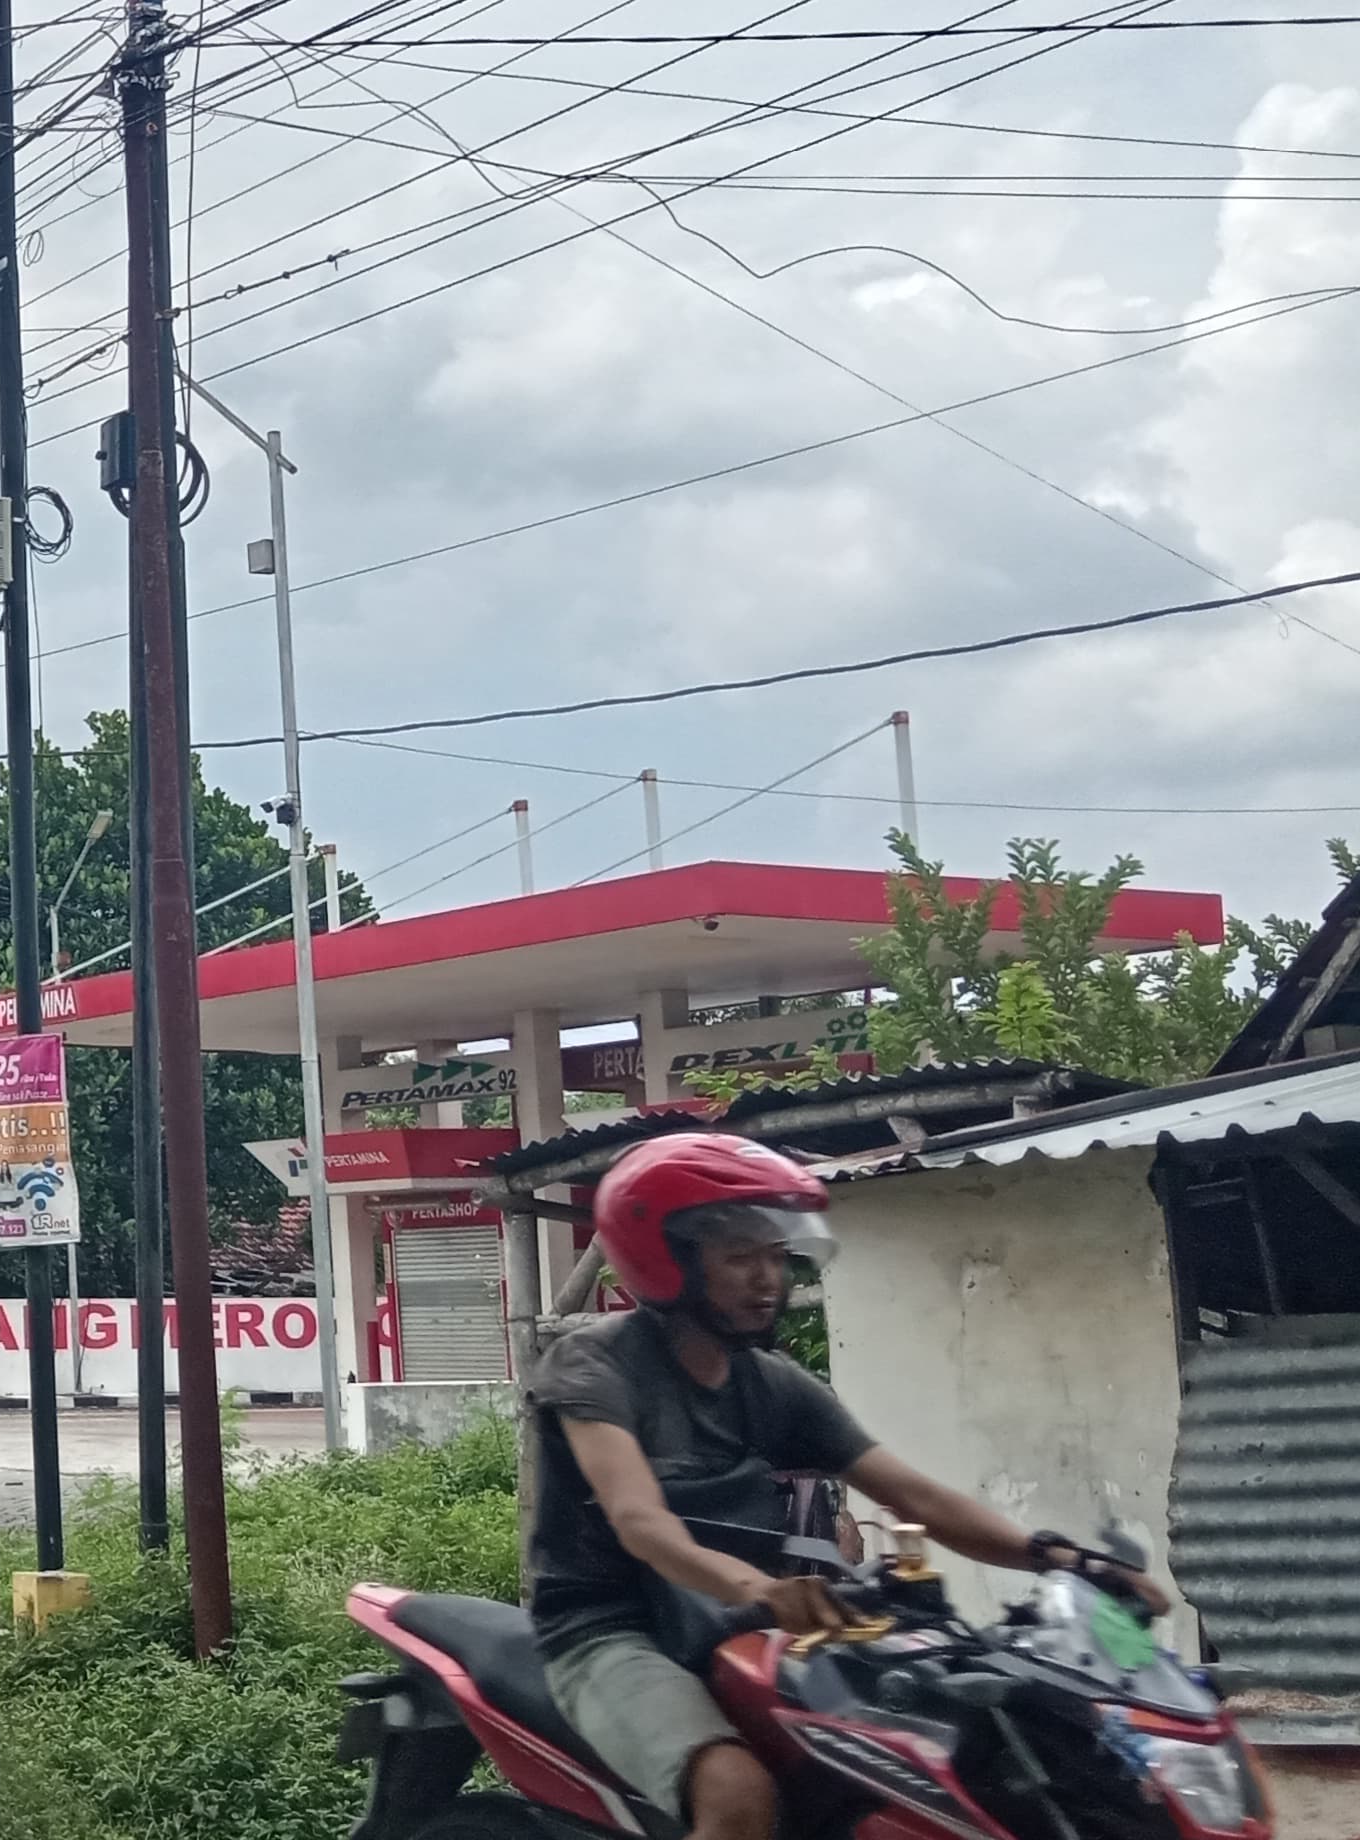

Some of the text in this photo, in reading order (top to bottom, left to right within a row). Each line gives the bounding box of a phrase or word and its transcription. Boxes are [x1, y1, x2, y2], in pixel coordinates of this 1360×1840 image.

[0, 986, 76, 1027] PEMINA
[593, 1047, 645, 1078] PERTA
[670, 1032, 868, 1072] DEXLT
[342, 1069, 517, 1108] PERTAMAX 92
[324, 1151, 391, 1168] PERTAMINA
